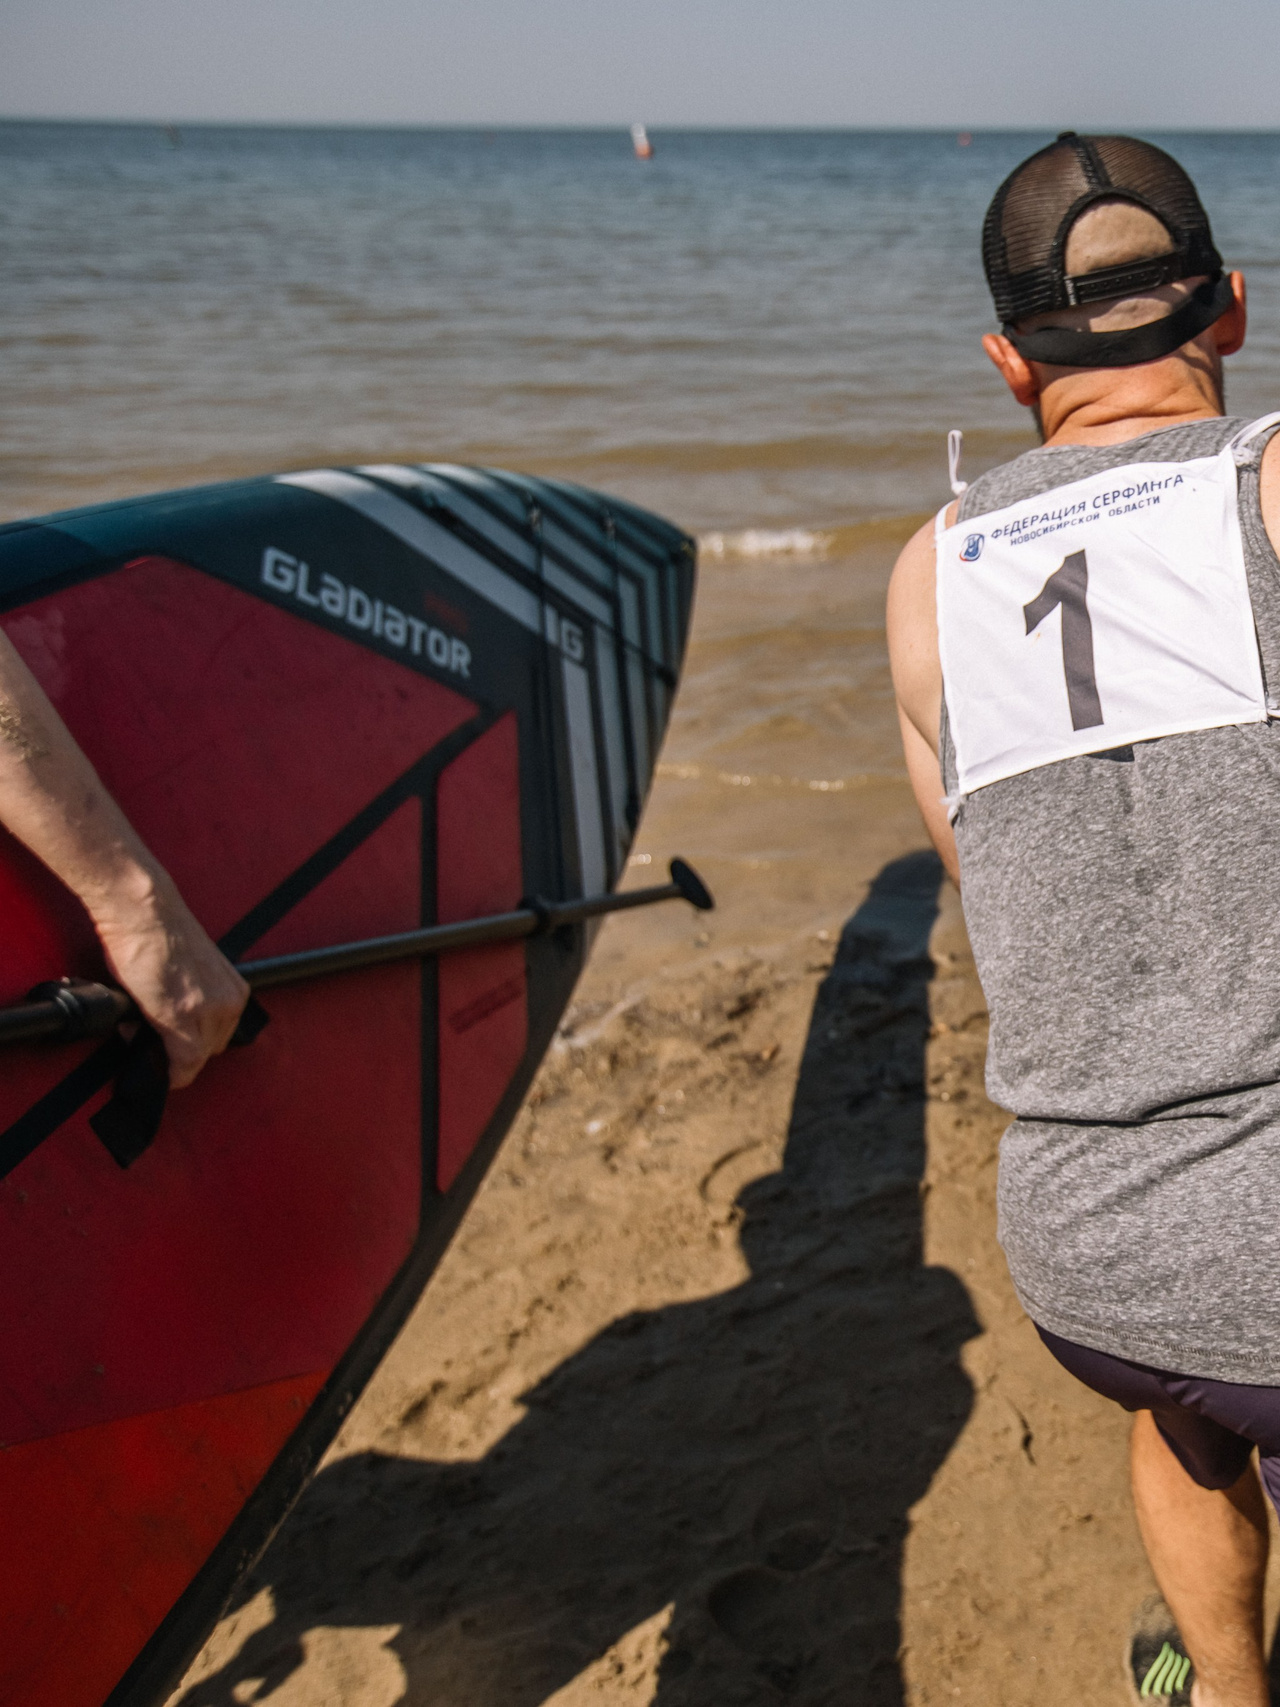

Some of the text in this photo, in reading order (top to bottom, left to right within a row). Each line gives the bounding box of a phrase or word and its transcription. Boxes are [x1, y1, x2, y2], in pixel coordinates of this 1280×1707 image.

[991, 474, 1184, 539] ФЕДЕРАЦИЯ СЕРФИНГА
[1108, 495, 1161, 517] ОБЛАСТИ
[1023, 548, 1105, 732] 1
